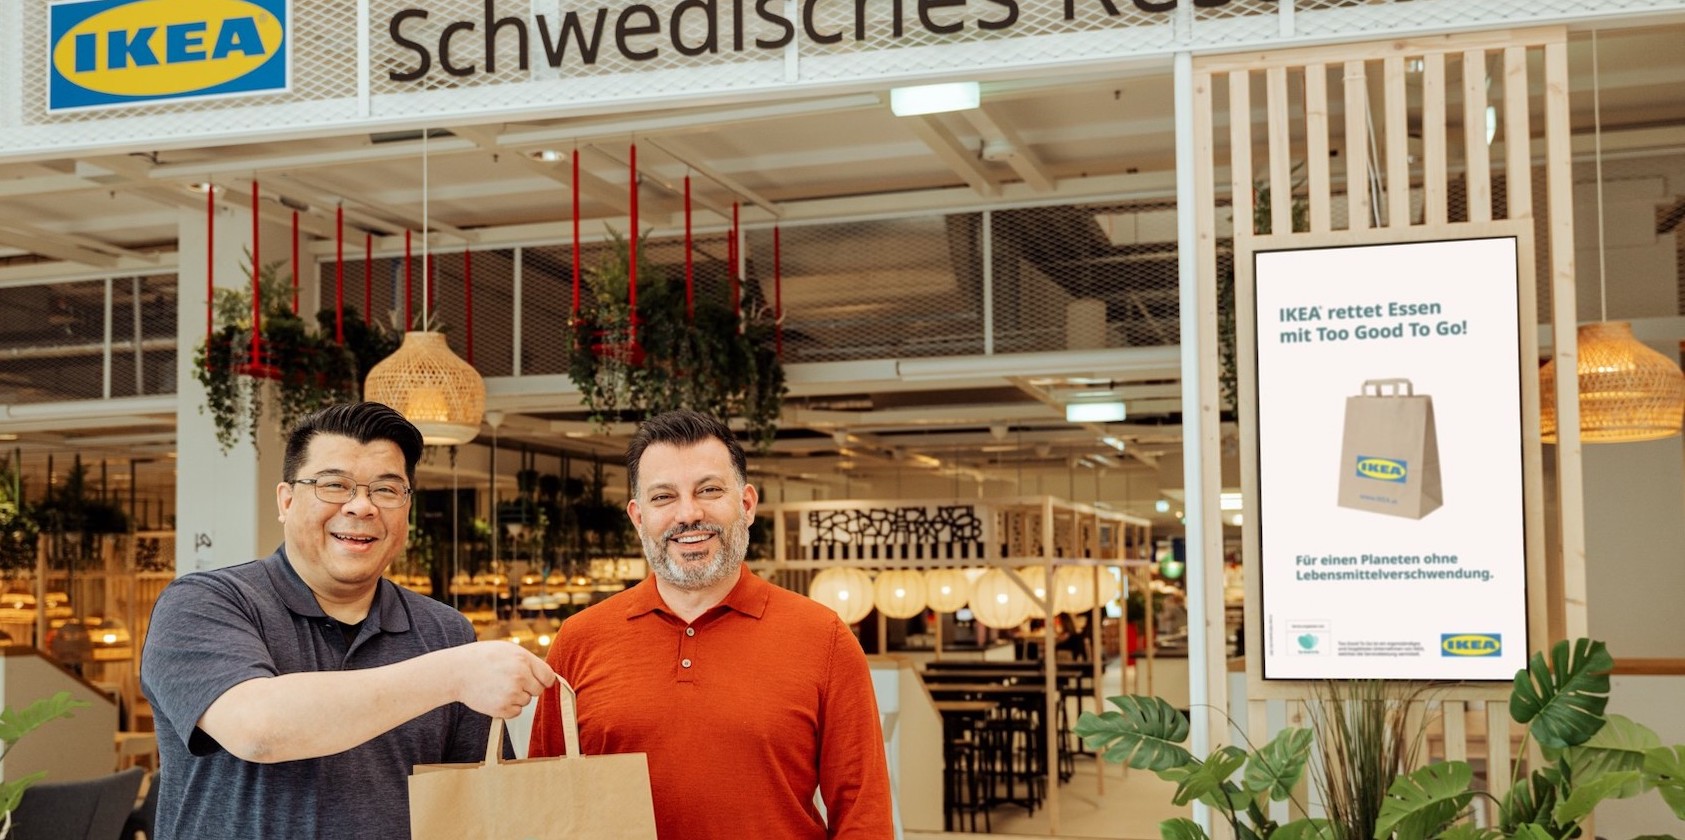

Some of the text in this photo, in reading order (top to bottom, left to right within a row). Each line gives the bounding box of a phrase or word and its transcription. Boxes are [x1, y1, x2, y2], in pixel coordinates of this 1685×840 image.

[74, 16, 266, 73] IKEA
[1279, 302, 1442, 322] IKEA rettet Essen
[1279, 320, 1468, 343] mit Too Good To Go!
[1361, 462, 1402, 476] IKEA
[1295, 553, 1459, 566] Für einen Planeten ohne
[1295, 568, 1495, 582] Lebensmittelverschwendung.
[1447, 640, 1496, 650] IKEA
